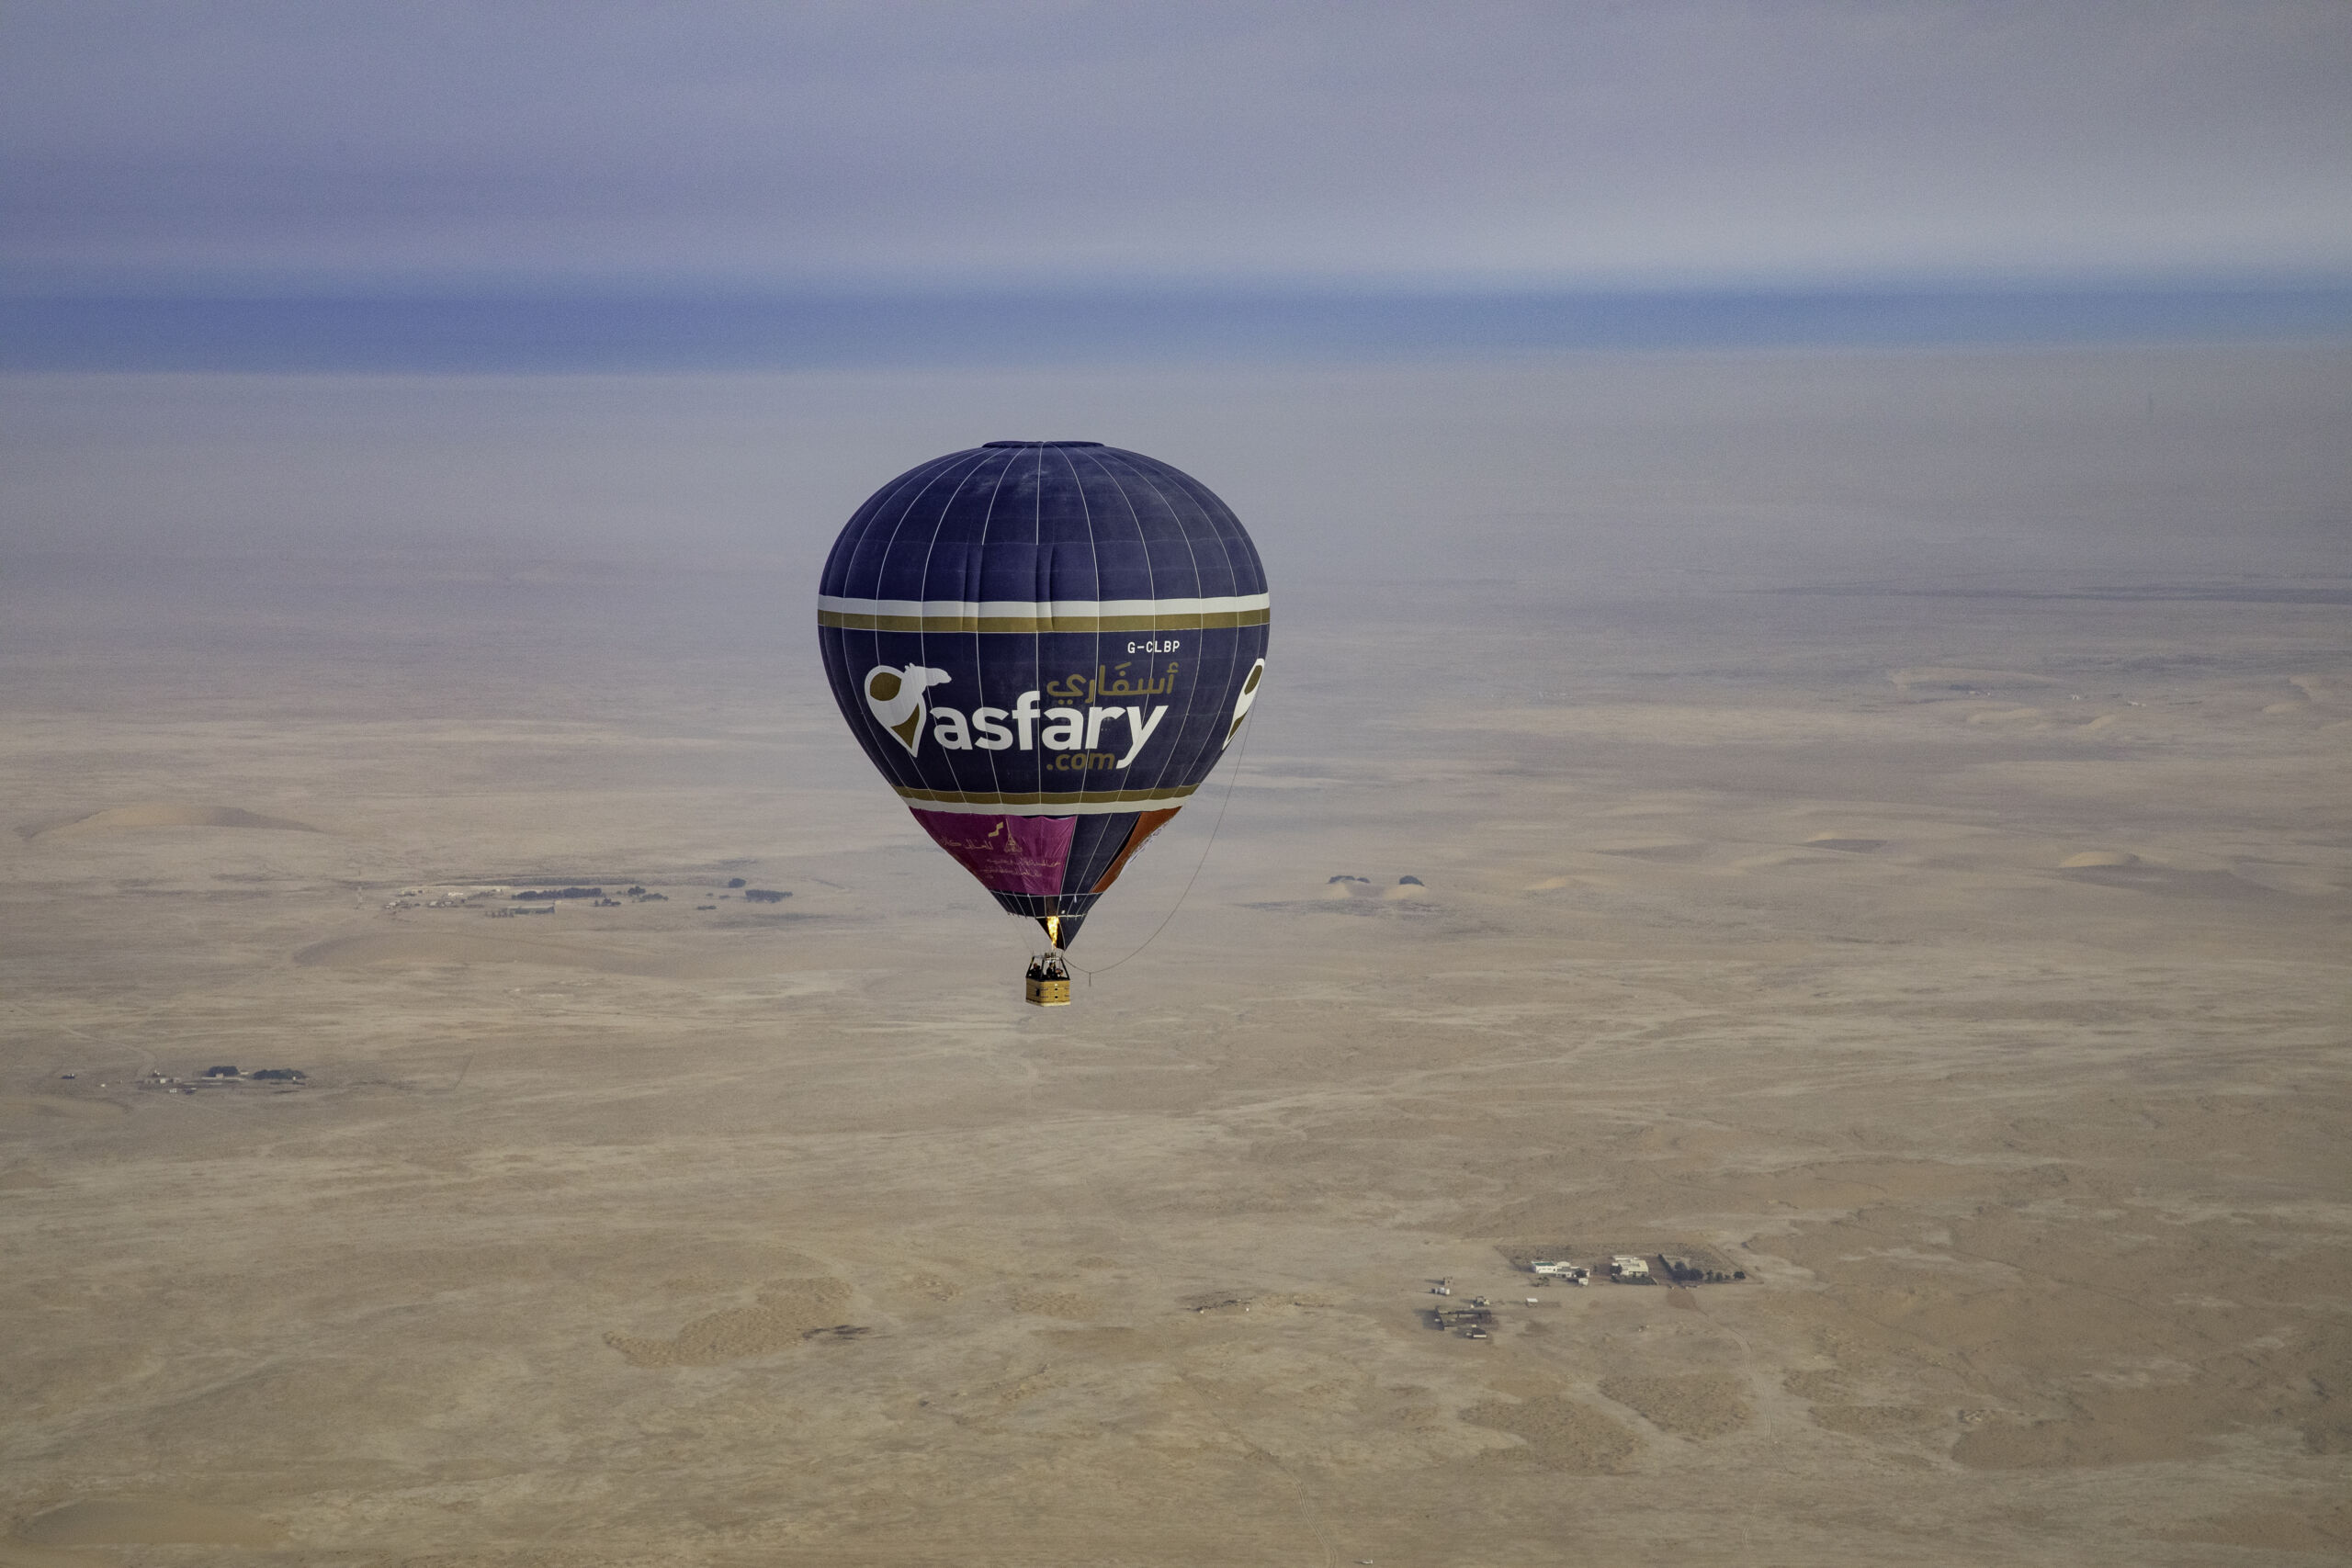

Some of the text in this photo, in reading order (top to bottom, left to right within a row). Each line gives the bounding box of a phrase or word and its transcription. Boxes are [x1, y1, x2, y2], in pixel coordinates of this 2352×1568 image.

[1127, 640, 1181, 654] G-CLBP
[930, 691, 1169, 769] asfary
[1046, 752, 1115, 771] .com
